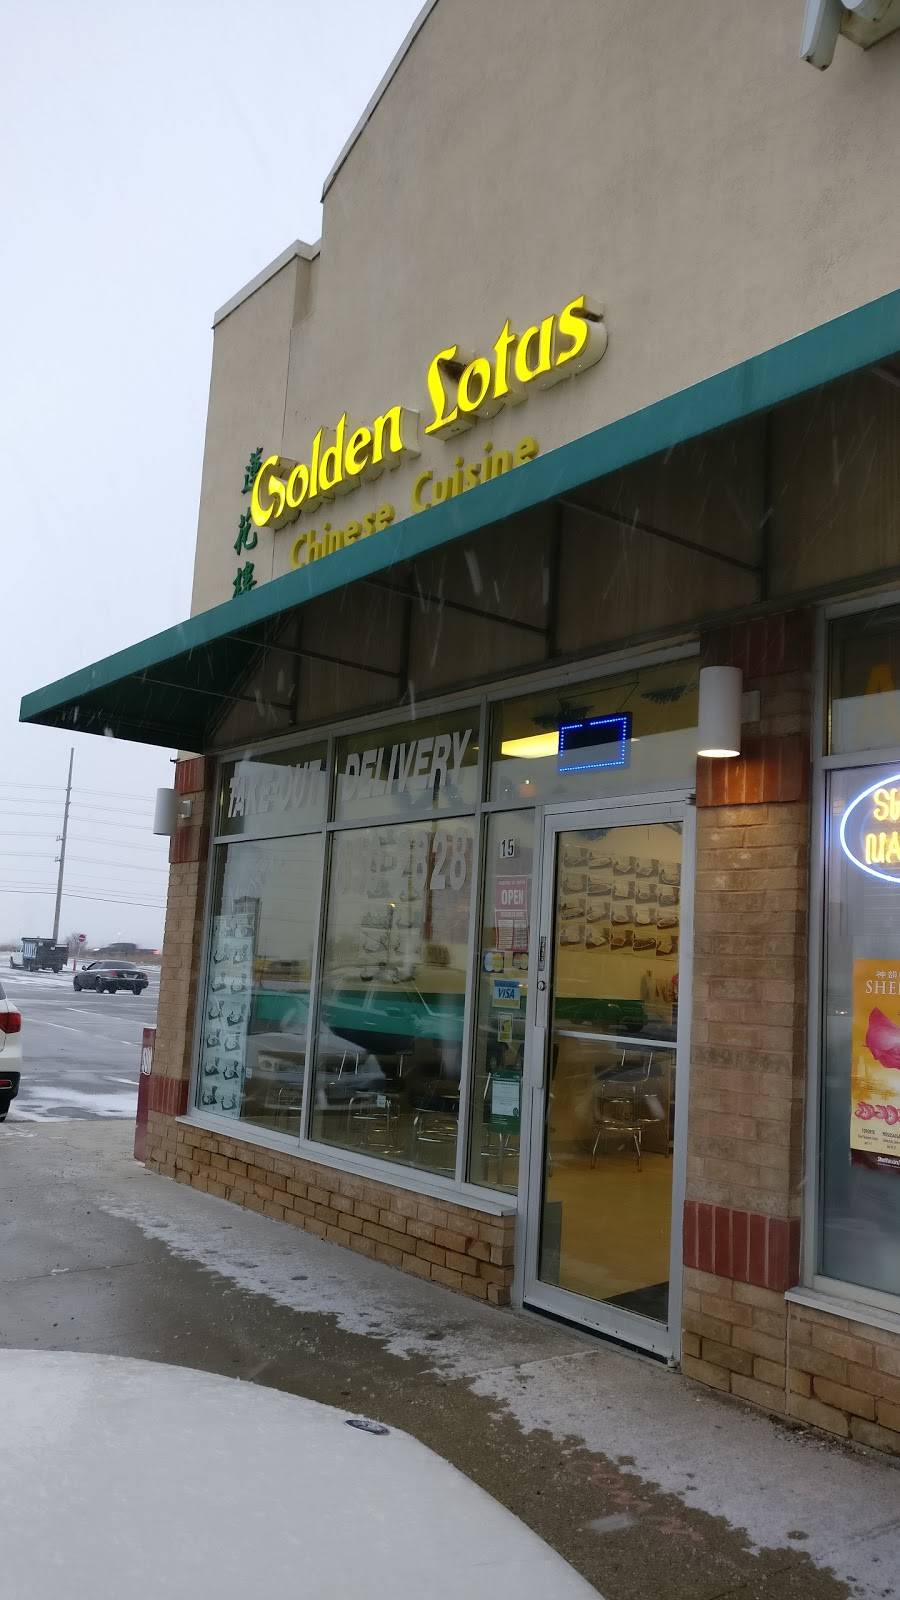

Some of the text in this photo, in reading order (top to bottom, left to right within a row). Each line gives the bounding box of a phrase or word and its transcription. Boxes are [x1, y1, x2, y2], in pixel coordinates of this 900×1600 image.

[250, 405, 404, 528] Golden
[290, 435, 540, 569] Chinese Cuisine
[343, 728, 473, 801] DELIVERY
[501, 838, 515, 857] 15
[501, 889, 524, 905] OPEN
[498, 987, 515, 1001] VISA
[866, 979, 900, 996] SHE
